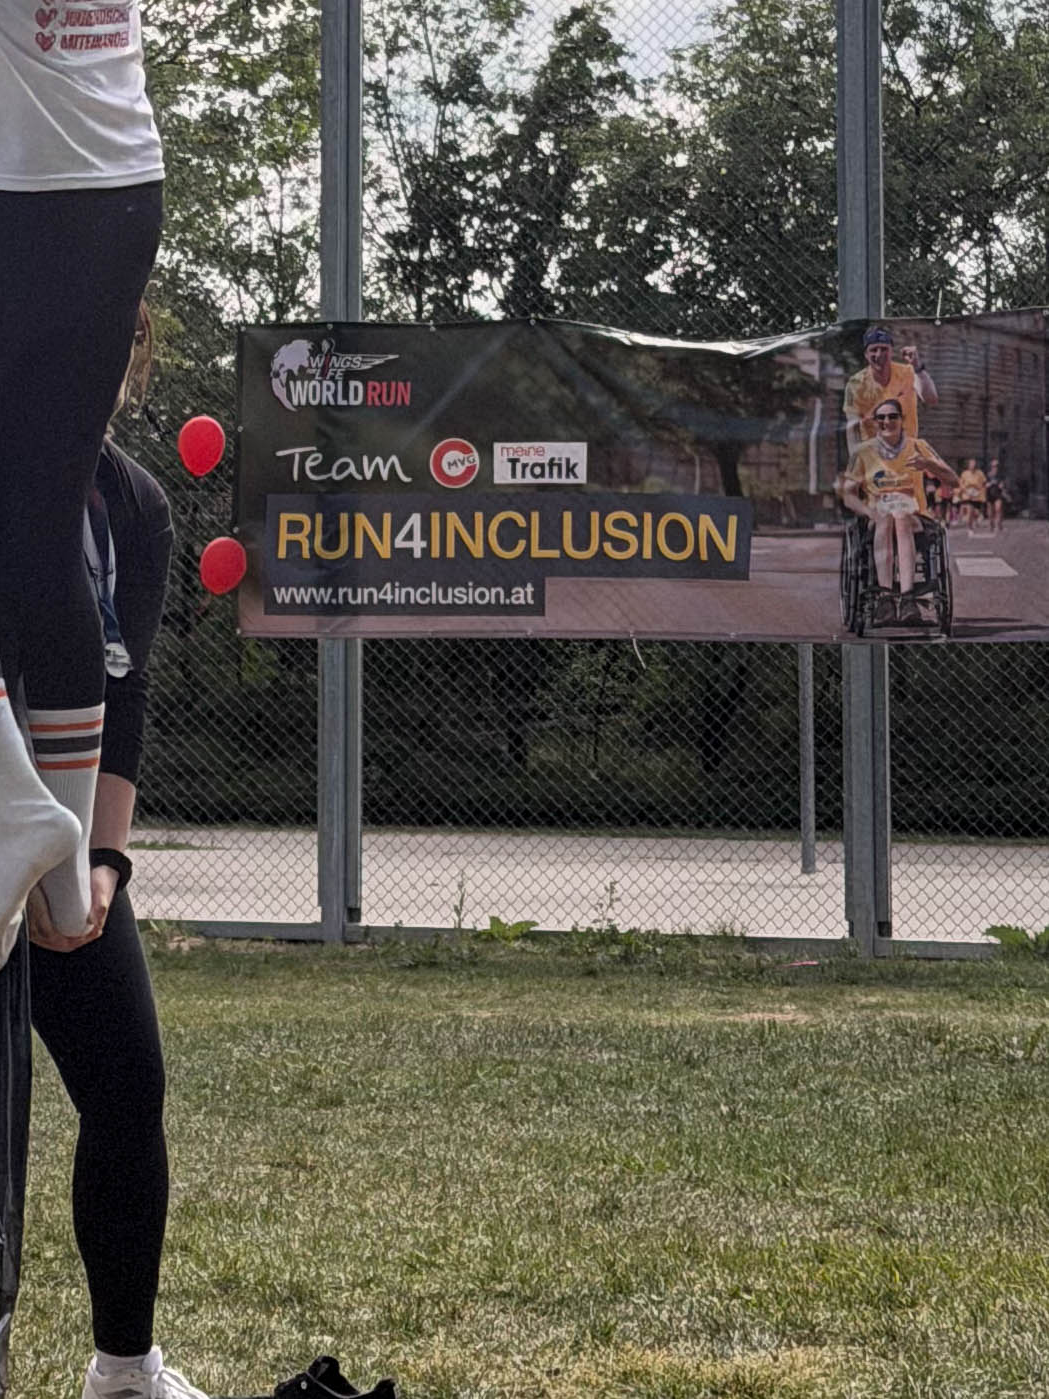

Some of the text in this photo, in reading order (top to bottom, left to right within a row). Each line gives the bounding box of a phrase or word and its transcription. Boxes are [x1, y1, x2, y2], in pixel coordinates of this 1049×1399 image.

[290, 380, 411, 406] WORLD RUN
[500, 446, 546, 457] meine
[275, 446, 476, 483] Team MVG
[507, 457, 579, 480] Trafik
[277, 510, 739, 563] RUN4INCLUSION
[273, 582, 535, 605] www.run4inclusion.at
